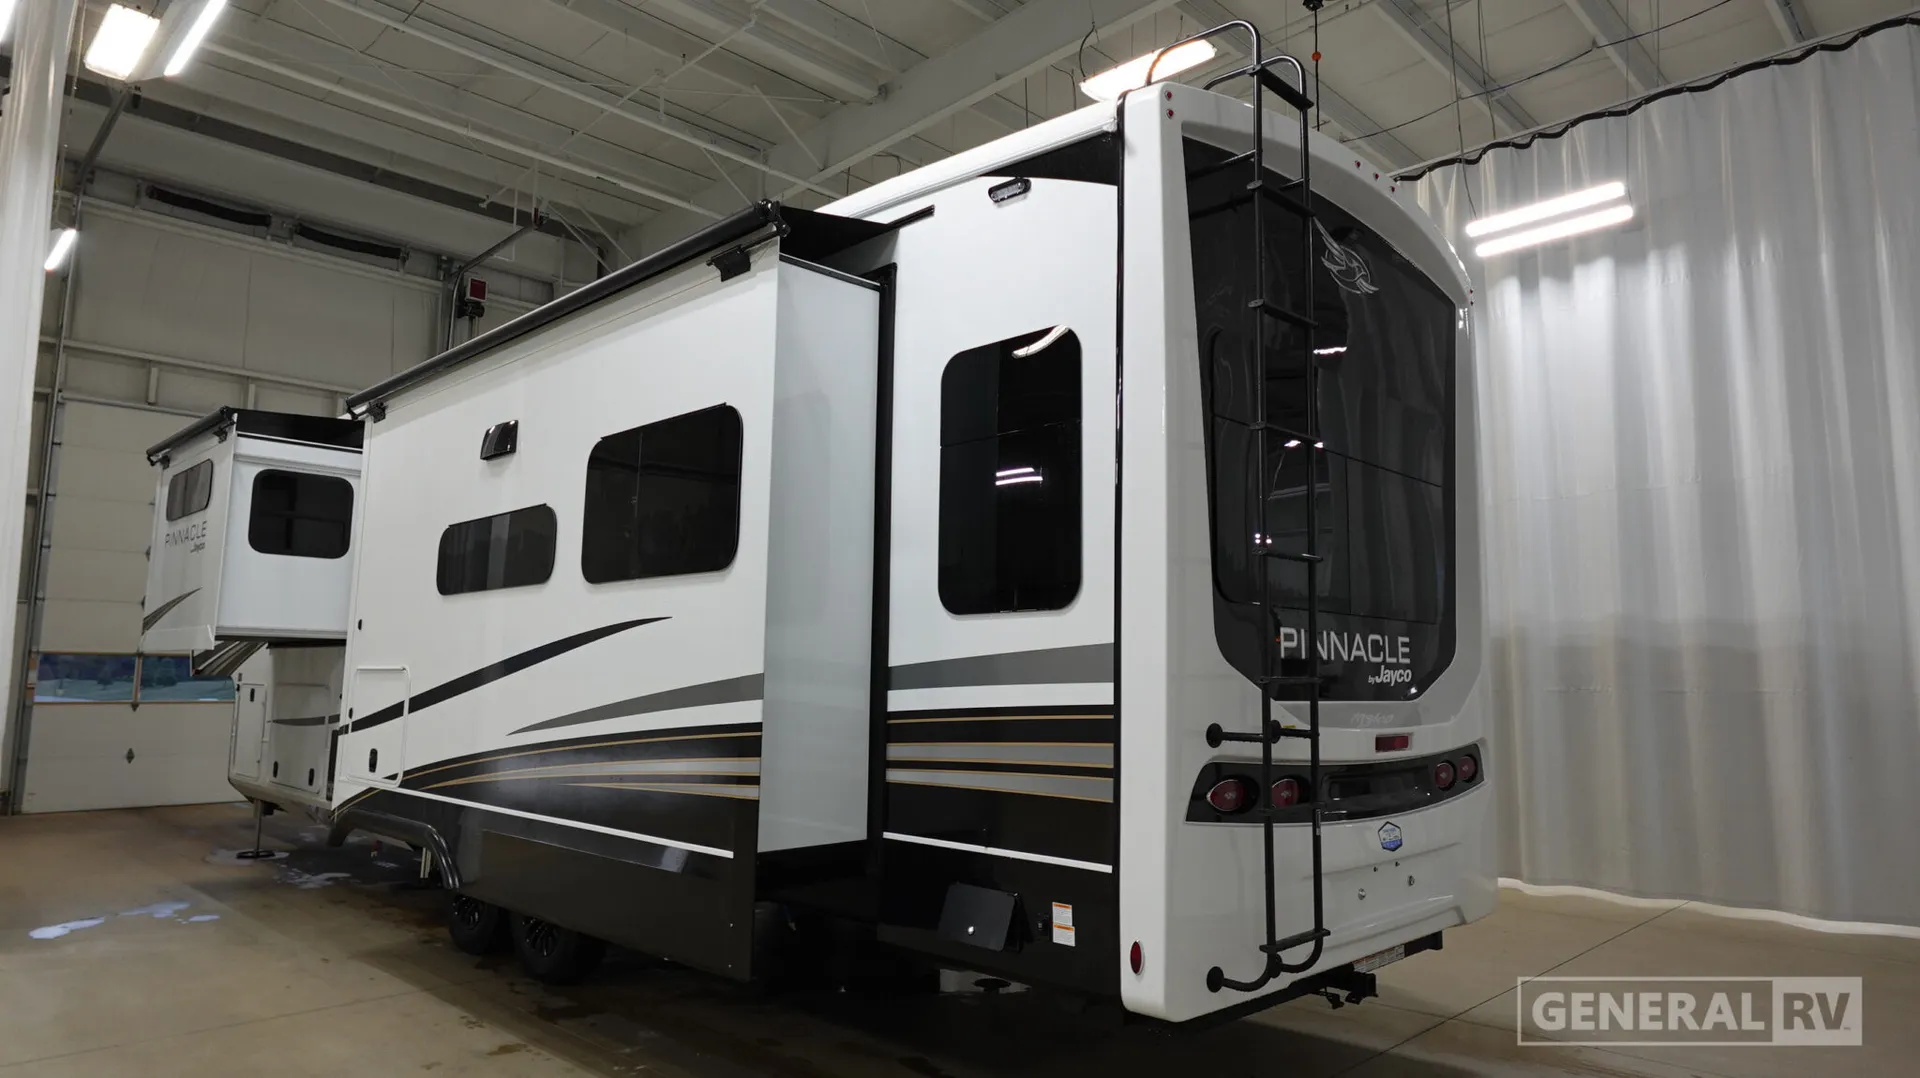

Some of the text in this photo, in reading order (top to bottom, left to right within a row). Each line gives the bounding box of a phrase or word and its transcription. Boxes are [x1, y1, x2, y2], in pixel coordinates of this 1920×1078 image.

[164, 520, 208, 548] PINNACLE
[1279, 626, 1411, 664] PINNACLE
[1368, 664, 1412, 687] by Jayco
